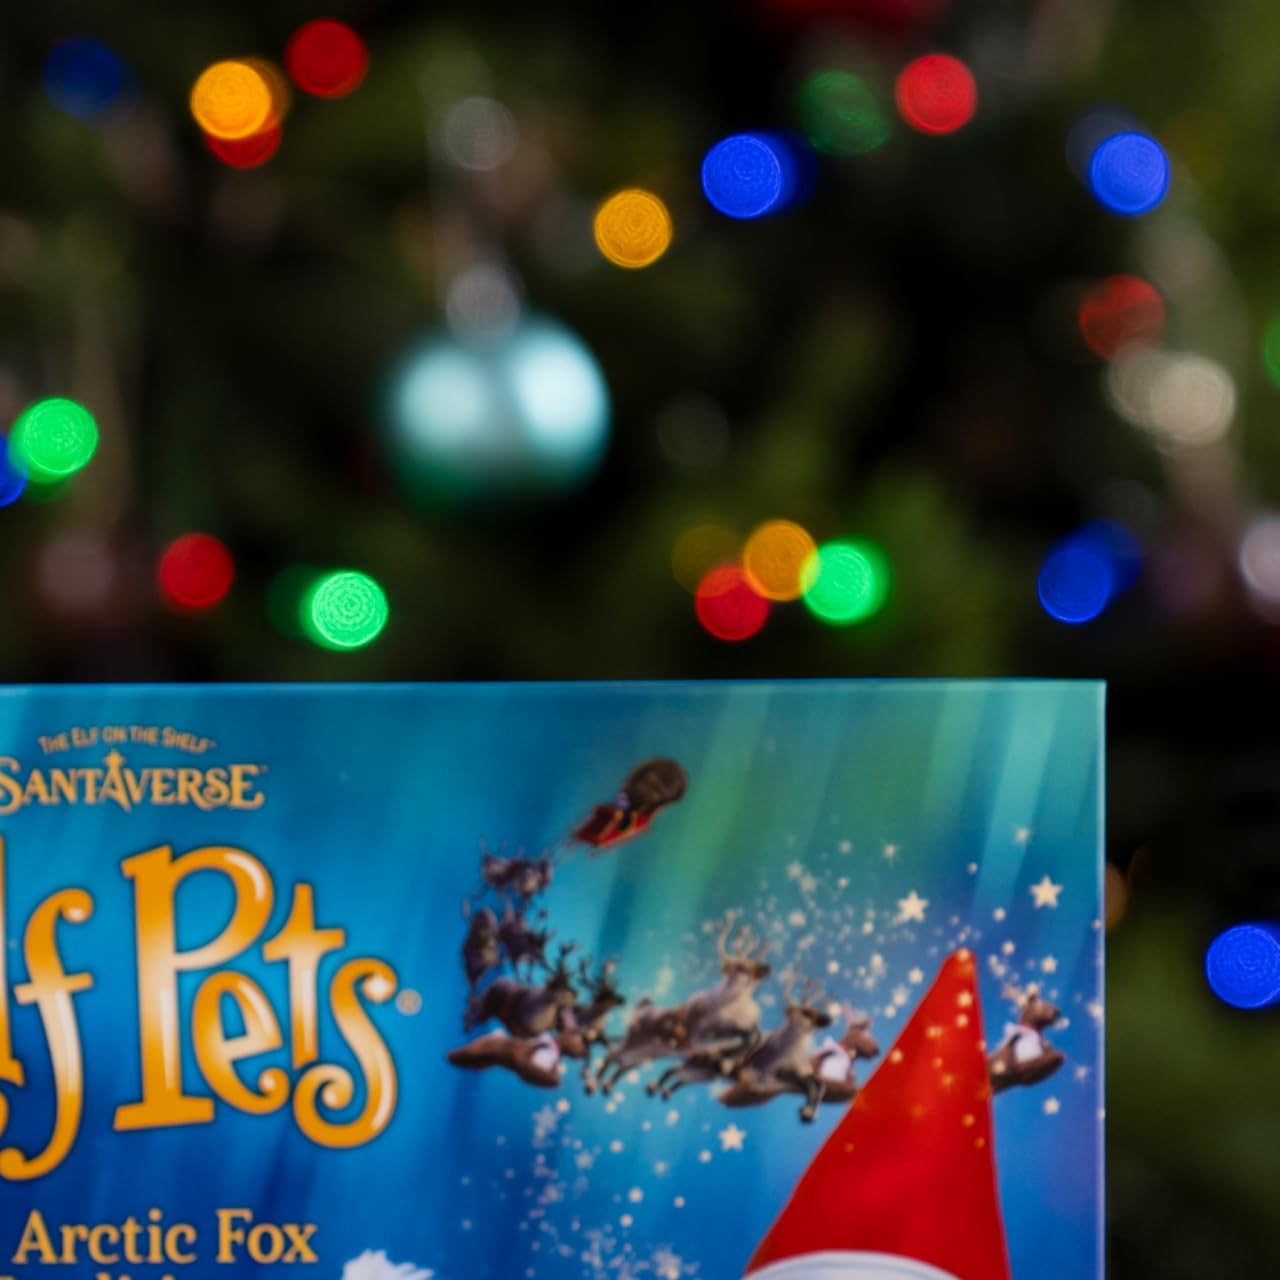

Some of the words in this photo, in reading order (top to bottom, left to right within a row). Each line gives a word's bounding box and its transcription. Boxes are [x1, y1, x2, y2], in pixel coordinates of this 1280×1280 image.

[71, 727, 99, 747] ELF
[130, 726, 158, 743] THE
[12, 1208, 197, 1264] Arctic
[215, 1209, 318, 1263] Fox
